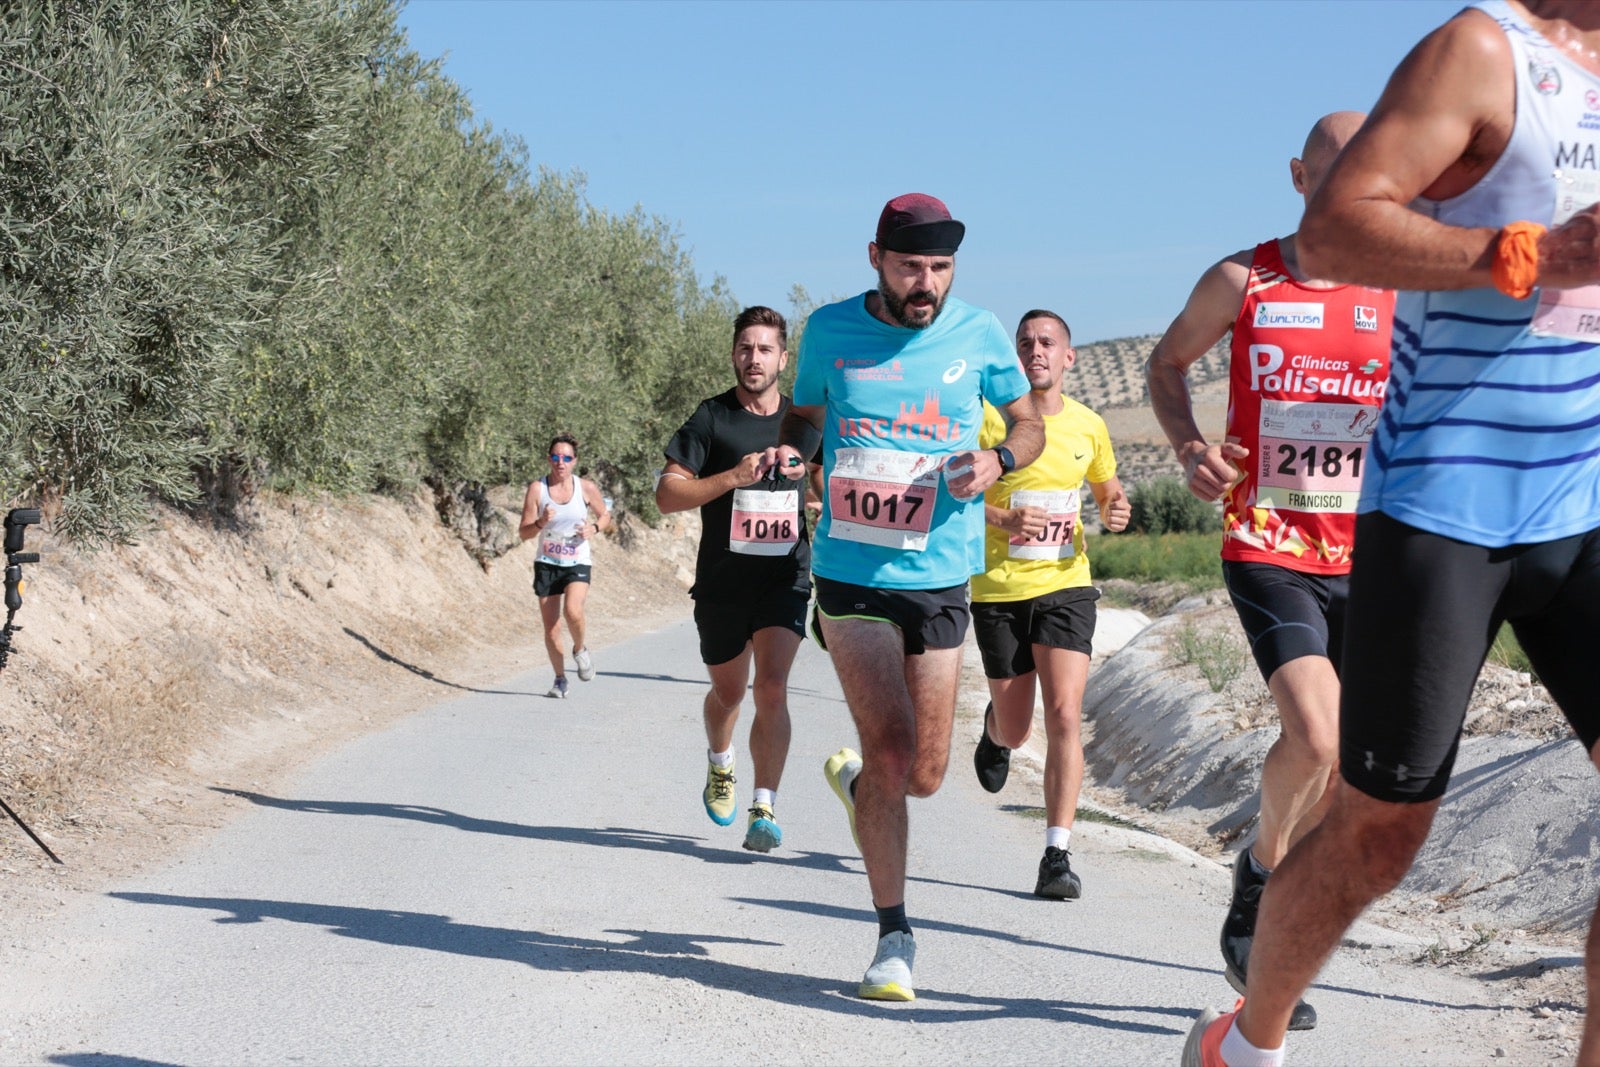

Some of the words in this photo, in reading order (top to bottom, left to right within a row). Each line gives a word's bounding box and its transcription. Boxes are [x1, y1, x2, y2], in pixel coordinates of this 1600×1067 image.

[1355, 321, 1377, 329] MOVE
[1291, 355, 1350, 371] Clínicas
[839, 417, 961, 441] BARCELONA
[1262, 450, 1271, 478] MASTER
[1277, 444, 1362, 478] 2181
[844, 489, 923, 524] 1017
[1288, 493, 1342, 508] FRANCISCO
[741, 518, 791, 539] 1018
[1025, 520, 1071, 542] 075
